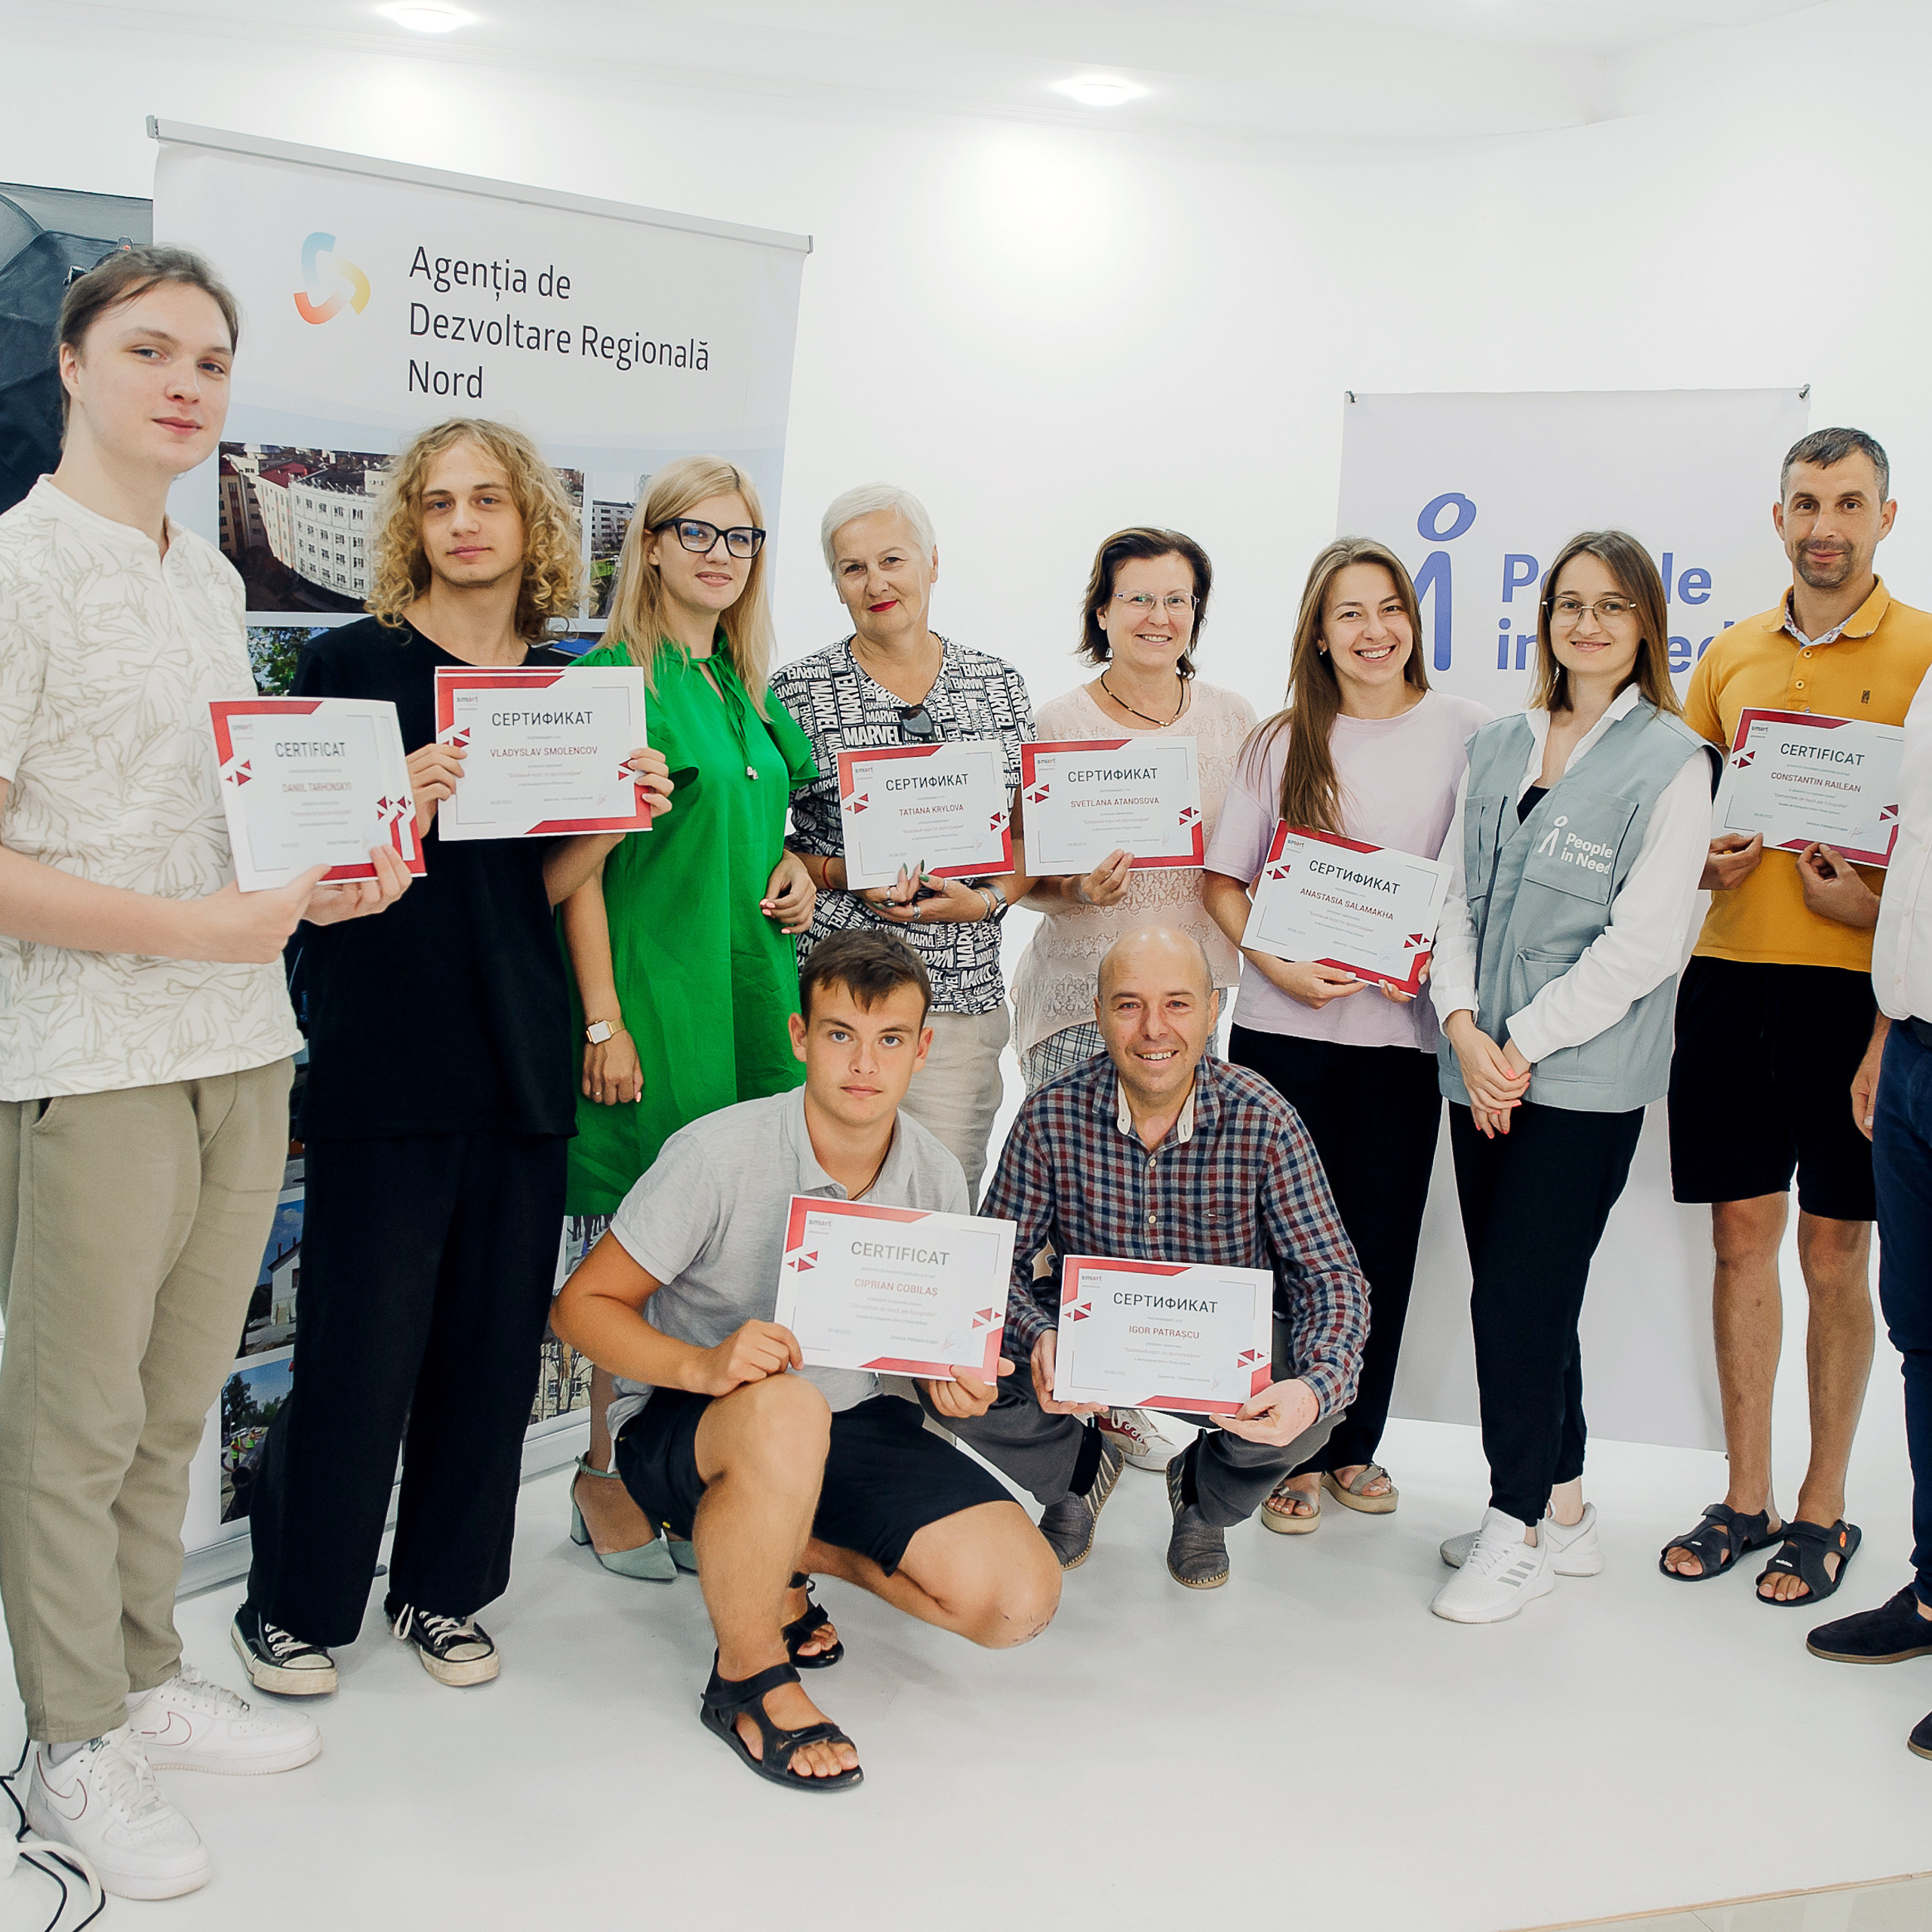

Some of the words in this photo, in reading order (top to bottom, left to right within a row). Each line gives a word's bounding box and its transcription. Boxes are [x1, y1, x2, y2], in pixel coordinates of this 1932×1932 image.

[537, 265, 571, 300] de
[410, 302, 571, 354] Dezvoltare
[581, 325, 709, 371] Regională
[408, 359, 483, 398] Nord
[1502, 552, 1712, 605] Ple
[809, 681, 840, 733] MARVEL
[833, 672, 865, 724] MARVEL
[983, 678, 1015, 729] MARVEL
[492, 711, 592, 726] СЕРТИФИКАТ
[866, 710, 901, 723] MARVEL
[842, 724, 903, 746] MARVEL
[275, 741, 346, 758] CERTIFICAT
[491, 748, 541, 757] VLADYSLAV
[544, 746, 598, 756] SMOLENCOV
[1780, 743, 1865, 766] CERTIFICAT
[885, 774, 968, 791] СЕРТИФИКАТ
[1068, 768, 1158, 783] СЕРТИФИКАТ
[1770, 772, 1823, 786] CONSTANTIN
[1825, 780, 1861, 792] RAILEAN
[899, 807, 931, 816] TATIANA
[932, 804, 964, 814] KRYLOVA
[1071, 799, 1112, 808] SVETLANA
[1115, 797, 1159, 805] ATANOSOVA
[1565, 832, 1613, 858] People
[1560, 847, 1574, 863] in
[1576, 852, 1612, 875] Need
[1309, 860, 1400, 895] СЕРТИФИКАТ
[1300, 888, 1343, 906] ANASTASIA
[1344, 900, 1393, 921] SALAMAKHA
[906, 932, 936, 948] MARVEL
[808, 1219, 832, 1227] smart
[851, 1241, 950, 1266] CERTIFICAT
[854, 1278, 894, 1291] CIPRIAN
[1113, 1292, 1218, 1313] СЕРТИФИКАТ
[1128, 1325, 1150, 1334] IGOR
